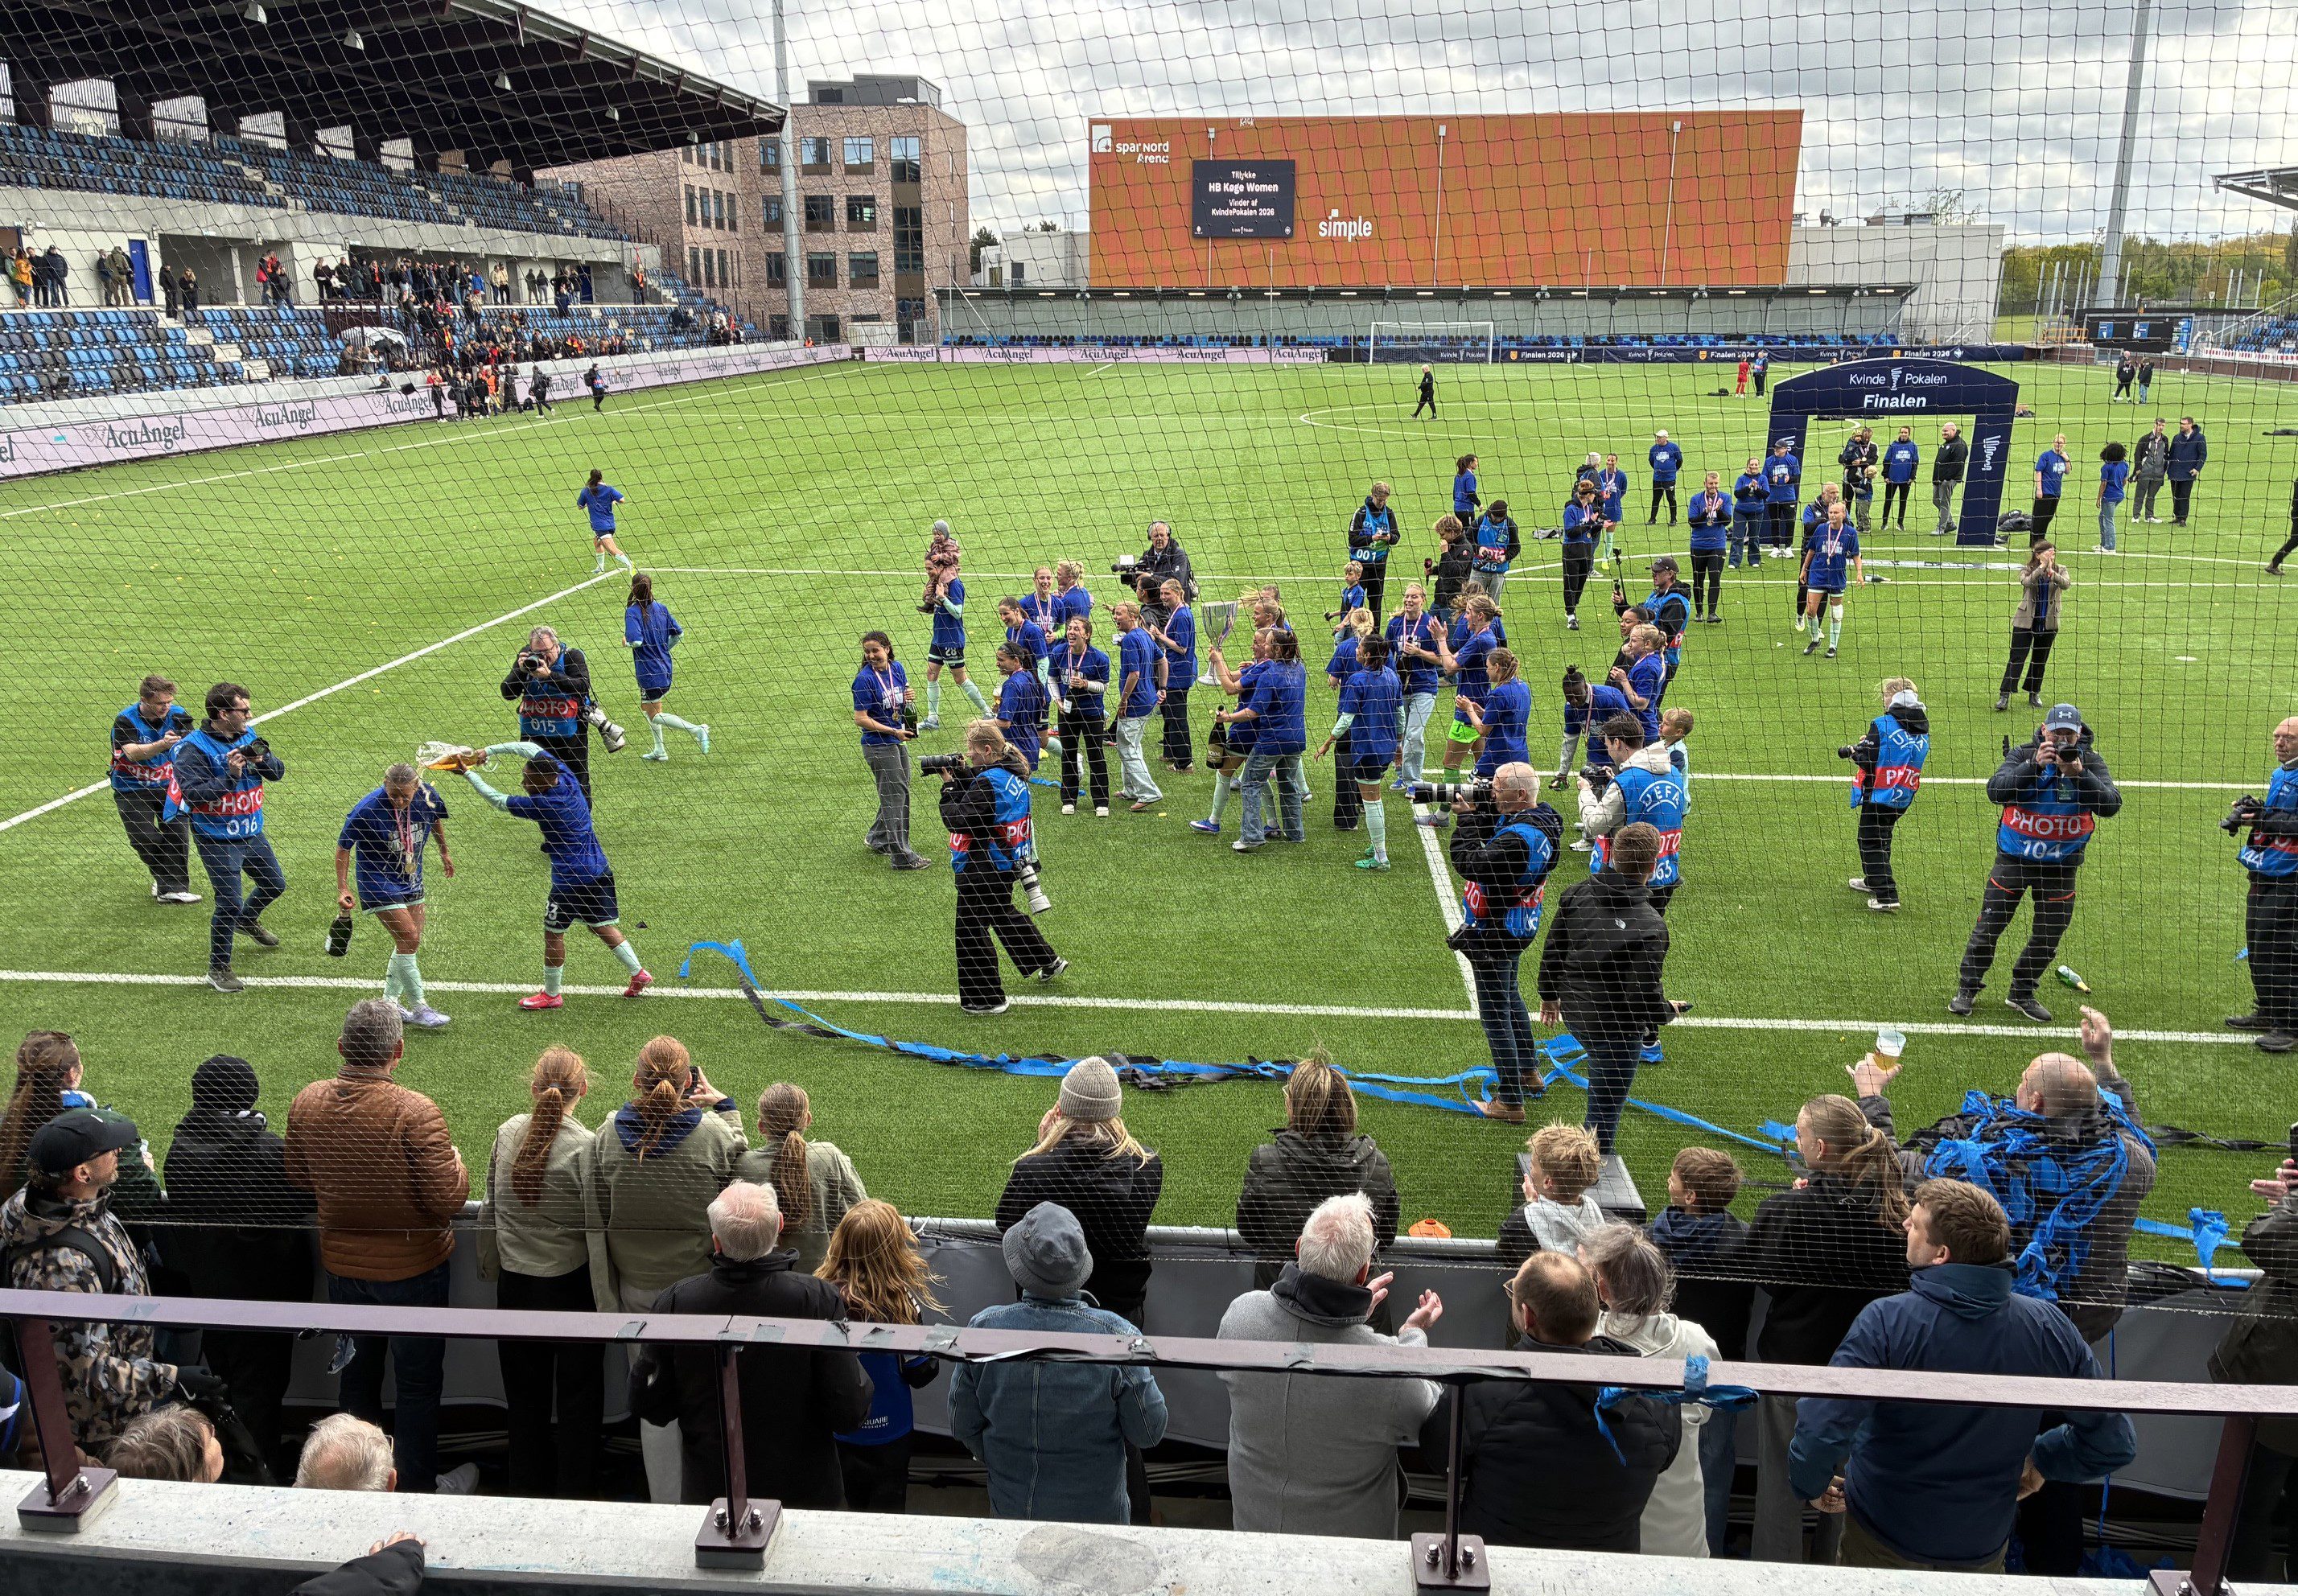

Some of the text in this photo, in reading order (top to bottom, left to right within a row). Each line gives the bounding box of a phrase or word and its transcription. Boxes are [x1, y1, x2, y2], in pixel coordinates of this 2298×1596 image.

[1231, 171, 1257, 181] Tillykke
[1209, 182, 1279, 195] HB Køge Women
[1229, 198, 1258, 207] Vinder af
[1211, 208, 1275, 216] KvindePokalen 2026
[1318, 215, 1373, 243] simple
[887, 348, 934, 361] AcuAngel
[985, 348, 1033, 361] AcuAngel
[1080, 348, 1129, 361] AcuAngel
[1177, 348, 1226, 361] AcuAngel
[1274, 348, 1323, 361] AcuAngel
[1521, 351, 1546, 359] Finalen
[1710, 351, 1736, 359] Finalen
[1849, 372, 1947, 385] Kvinde Pokalen
[385, 389, 432, 416] AcuAngel
[1864, 393, 1927, 409] Finalen
[254, 402, 317, 433] AcuAngel
[105, 416, 187, 451] AcuAngel
[1356, 549, 1377, 561] 001
[530, 718, 556, 733] 015
[226, 817, 257, 836] 016
[2010, 808, 2082, 836] PHOTO
[2022, 840, 2061, 859] 104
